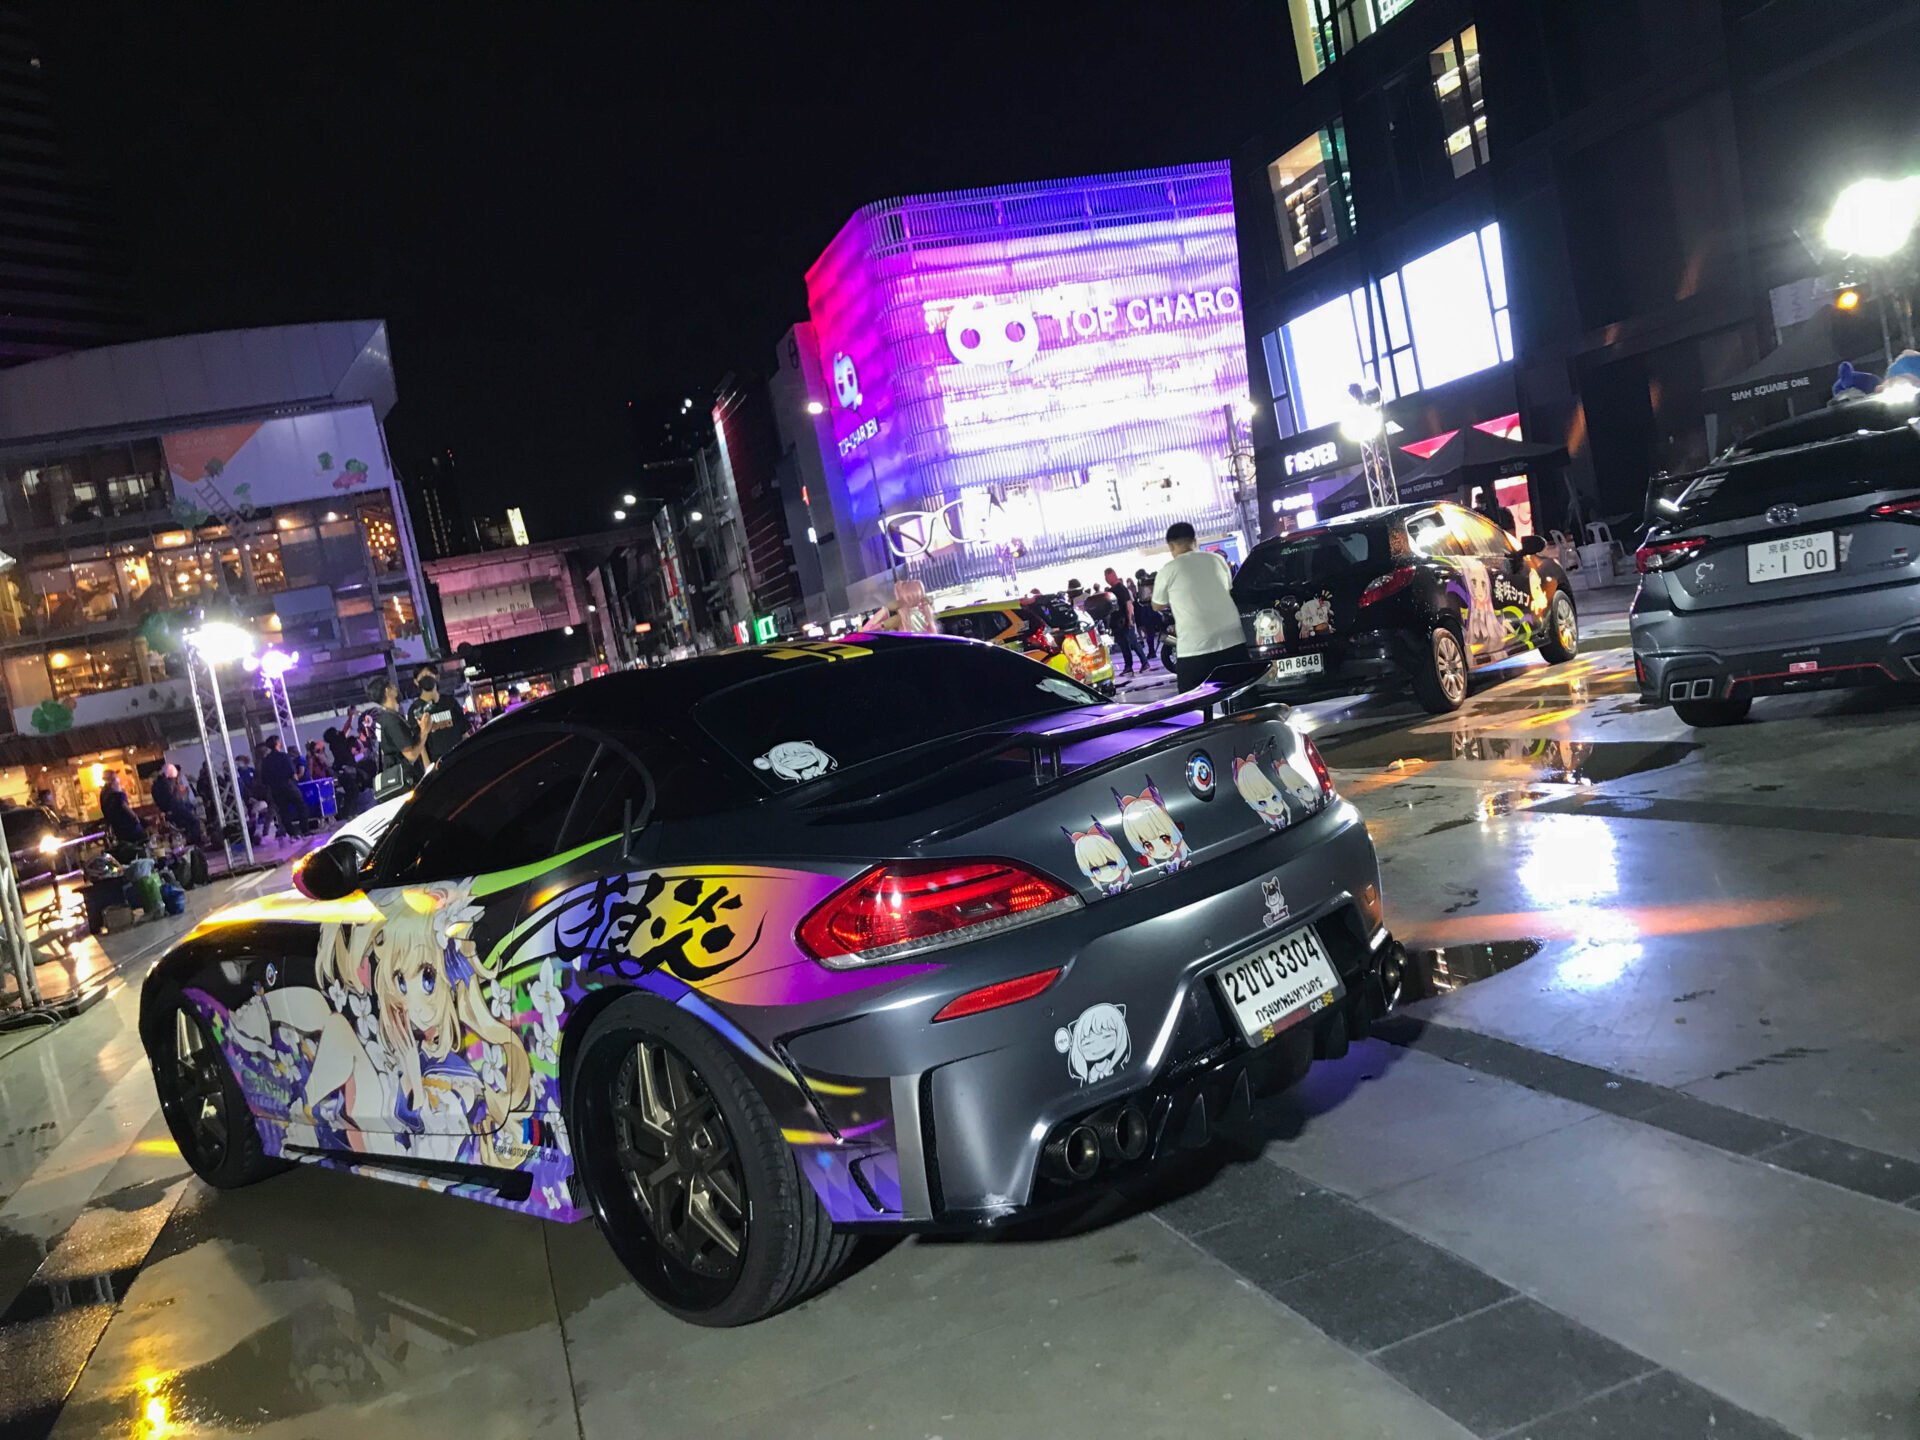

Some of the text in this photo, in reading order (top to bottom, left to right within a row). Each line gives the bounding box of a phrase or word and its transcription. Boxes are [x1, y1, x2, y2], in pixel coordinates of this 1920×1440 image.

[1055, 303, 1118, 343] TOP
[1731, 376, 1809, 401] SIAM SQUARE ONE
[1295, 654, 1320, 669] 8648
[1268, 931, 1321, 980] 3304
